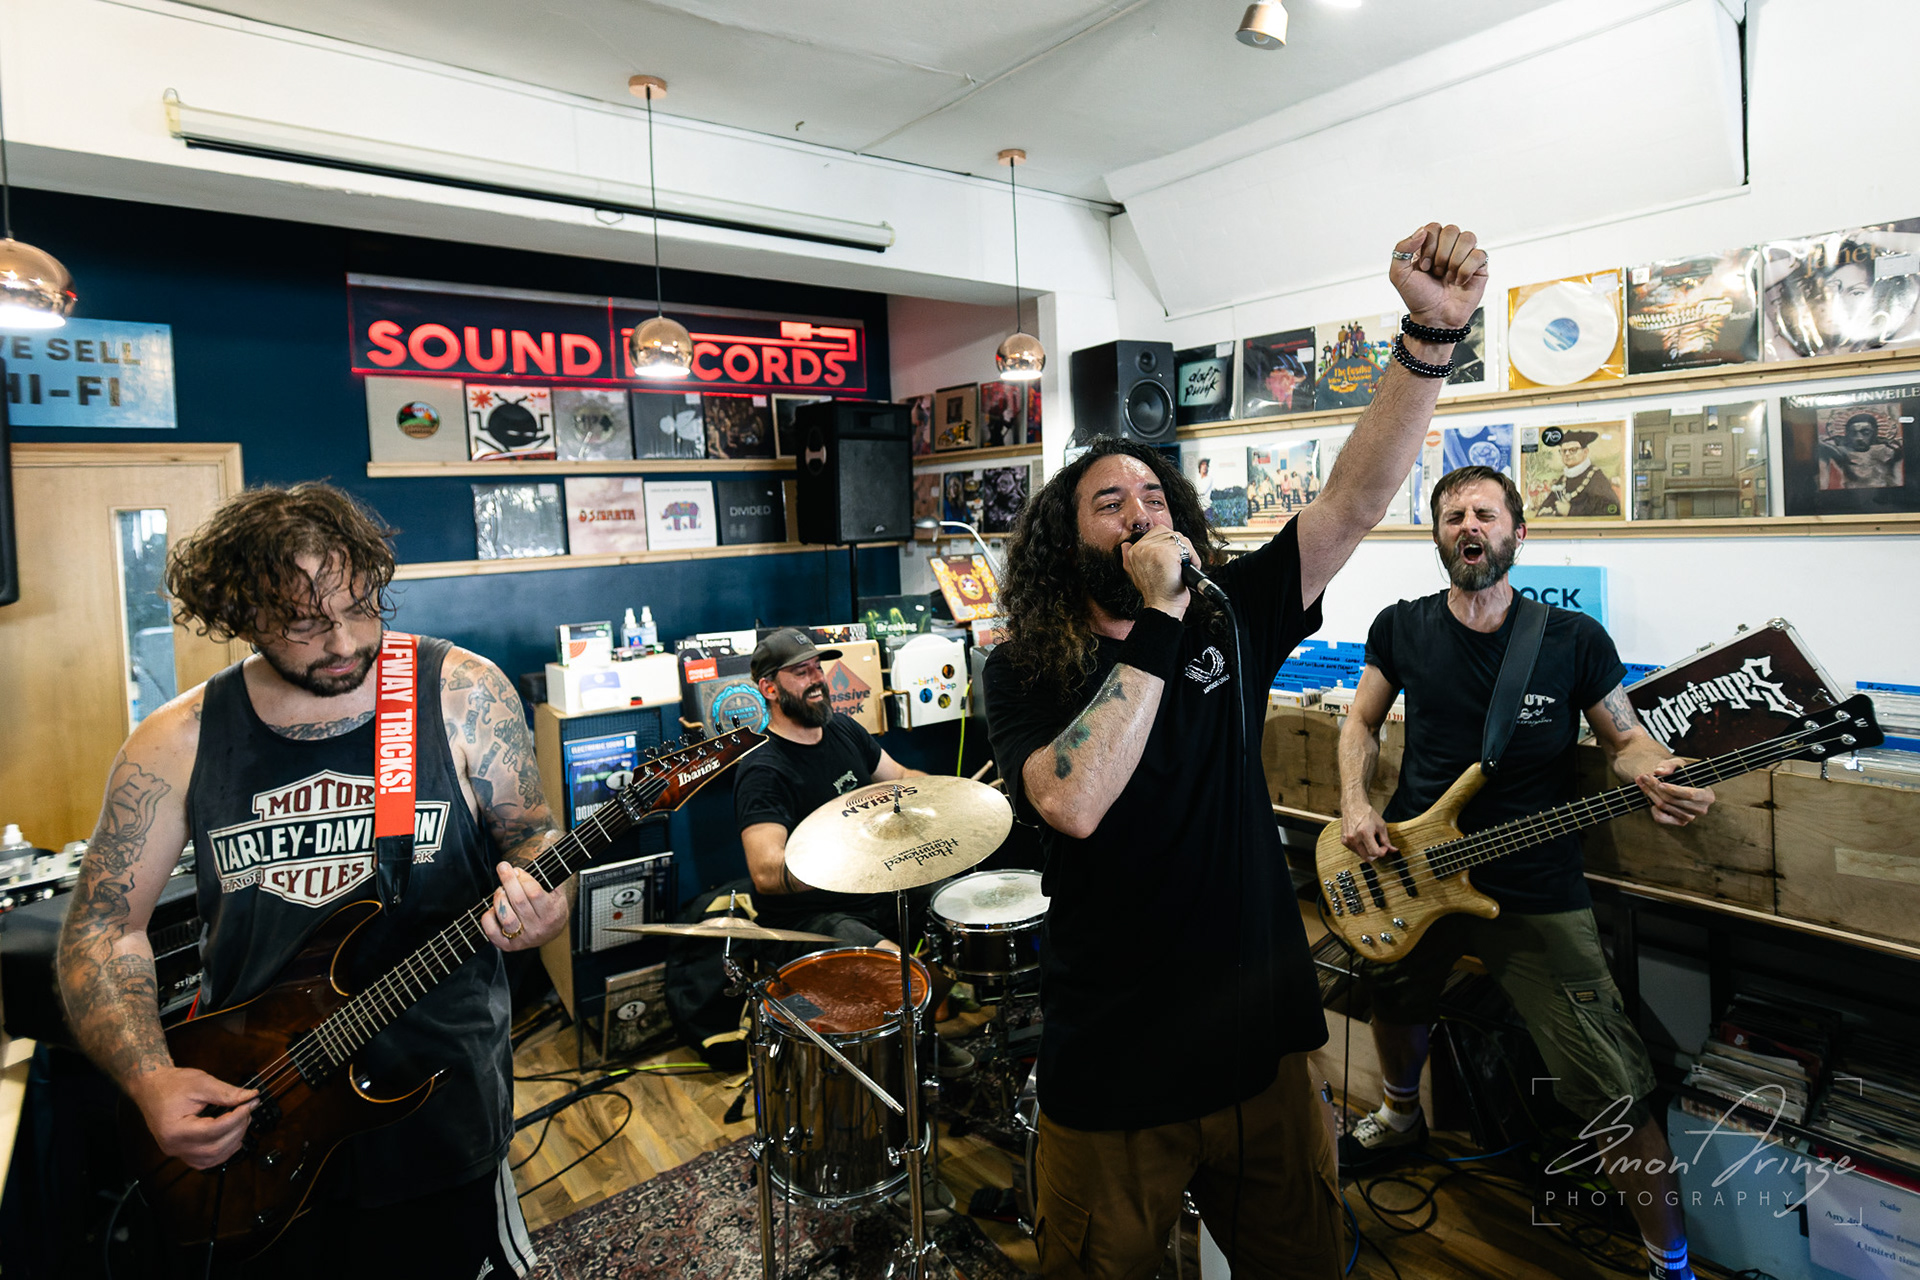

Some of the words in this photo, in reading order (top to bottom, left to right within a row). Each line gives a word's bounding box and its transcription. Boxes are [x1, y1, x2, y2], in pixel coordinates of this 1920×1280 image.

[0, 336, 32, 360] E
[47, 338, 141, 365] SELL
[367, 320, 602, 377] SOUND
[622, 326, 858, 386] CORDS
[1188, 366, 1221, 382] daft
[1184, 379, 1220, 402] punk
[1520, 587, 1582, 608] OCK
[381, 630, 413, 702] ALFWAY
[829, 688, 871, 701] assive
[832, 703, 865, 716] tack
[380, 708, 412, 795] TRICKS!
[677, 758, 721, 788] Ibanez
[269, 777, 375, 816] MOTOR
[915, 846, 953, 866] Hand
[272, 861, 365, 899] CYCLES
[621, 890, 635, 905] 2
[627, 1003, 637, 1019] 3
[1825, 1210, 1844, 1224] Any
